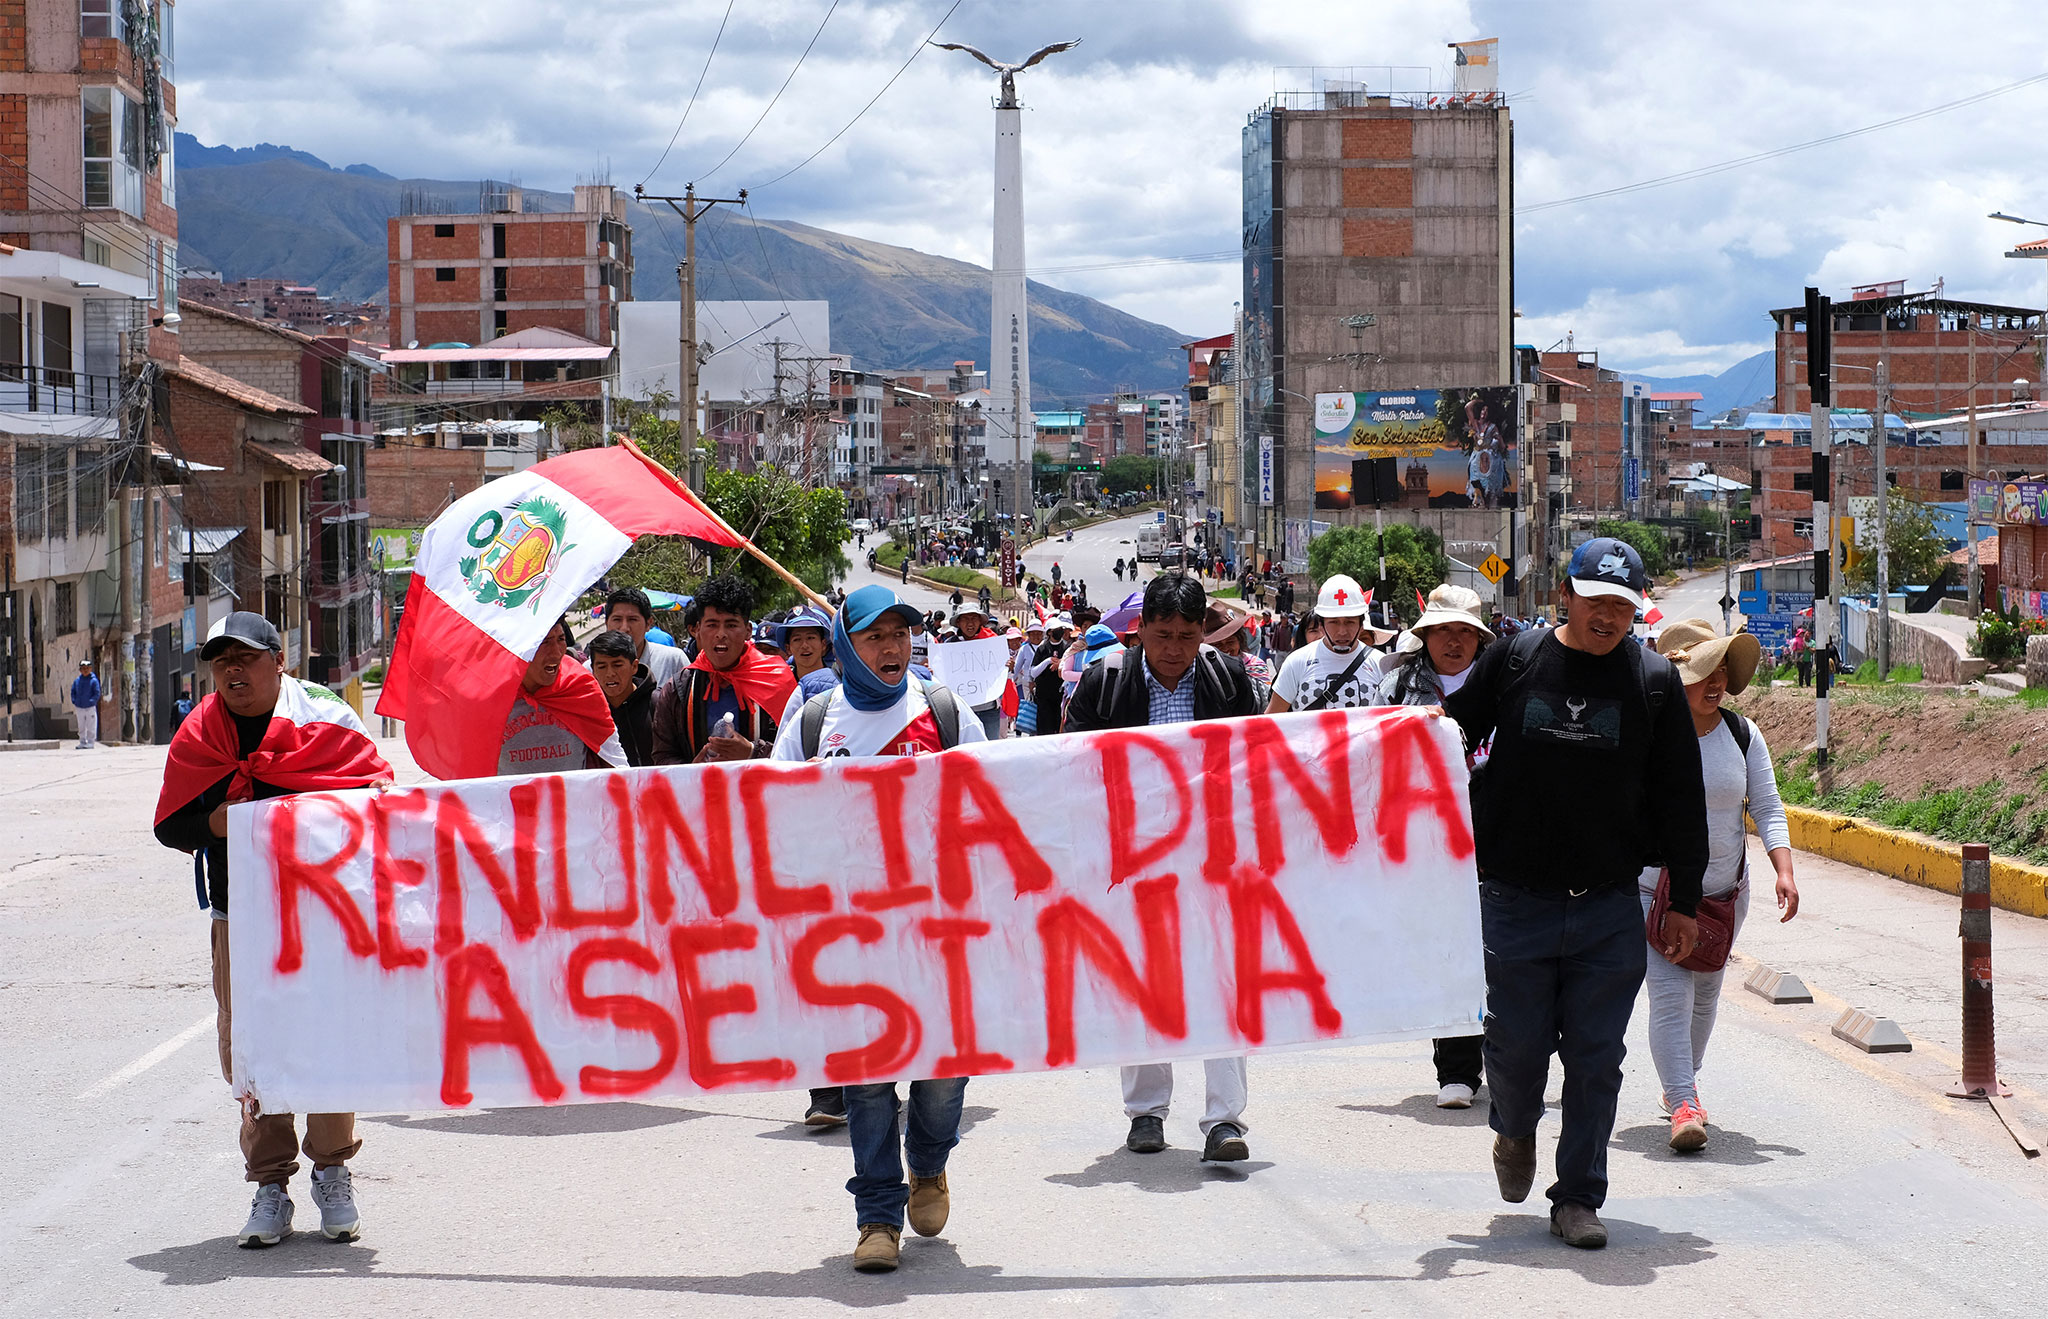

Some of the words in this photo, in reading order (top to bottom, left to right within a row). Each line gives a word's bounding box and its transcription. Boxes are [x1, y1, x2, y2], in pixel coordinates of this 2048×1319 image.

[1011, 318, 1019, 343] SAN
[1379, 396, 1416, 406] GLORIOSO
[1398, 410, 1426, 421] Patrón
[1352, 426, 1379, 446] San
[1380, 424, 1446, 446] Sebastián
[1262, 451, 1271, 501] DENTAL
[508, 743, 572, 763] FOOTBALL
[270, 752, 1054, 976] RENUNCIA
[1095, 711, 1476, 886] DINA
[437, 868, 1344, 1108] ASESINA
